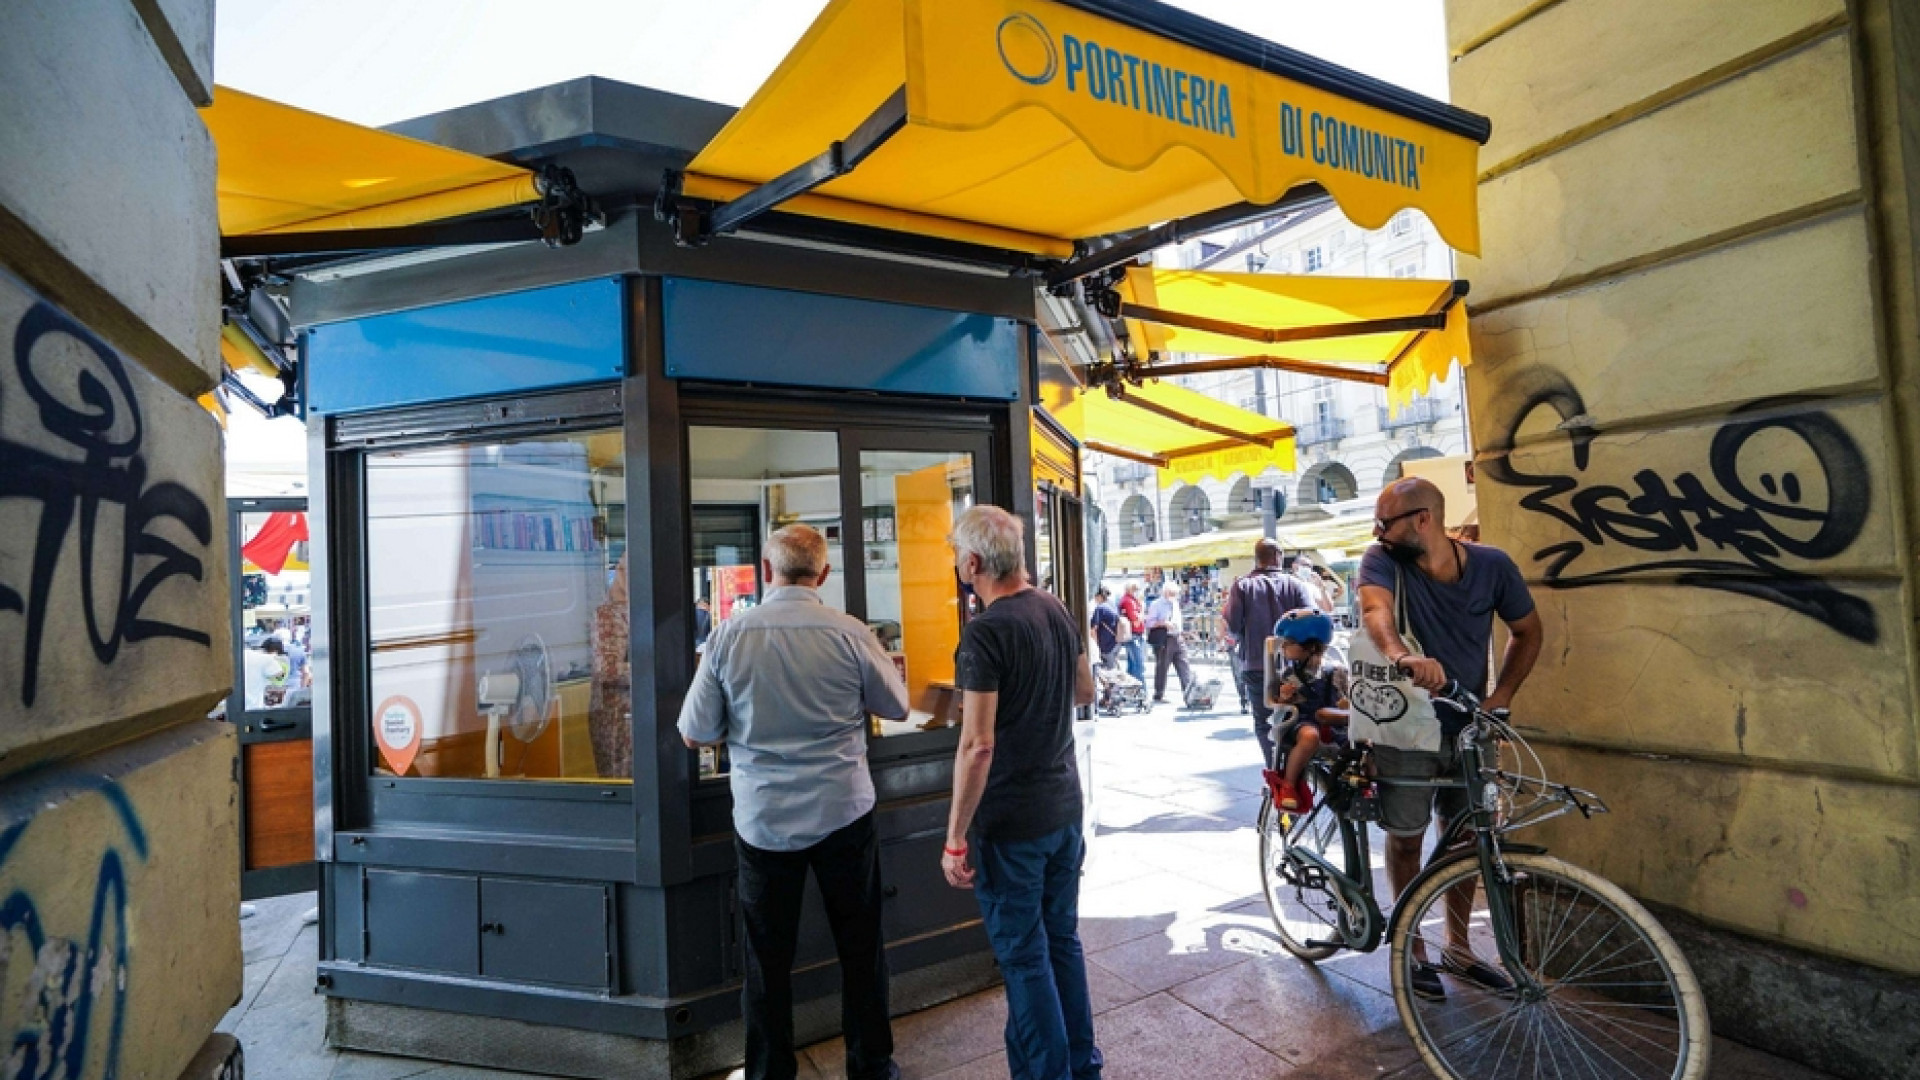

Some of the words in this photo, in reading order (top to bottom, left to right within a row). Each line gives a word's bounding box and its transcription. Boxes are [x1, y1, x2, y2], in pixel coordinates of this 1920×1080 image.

[1063, 34, 1236, 138] PORTINERIA
[1280, 102, 1304, 158] DI
[1311, 111, 1425, 191] COMUNITA'
